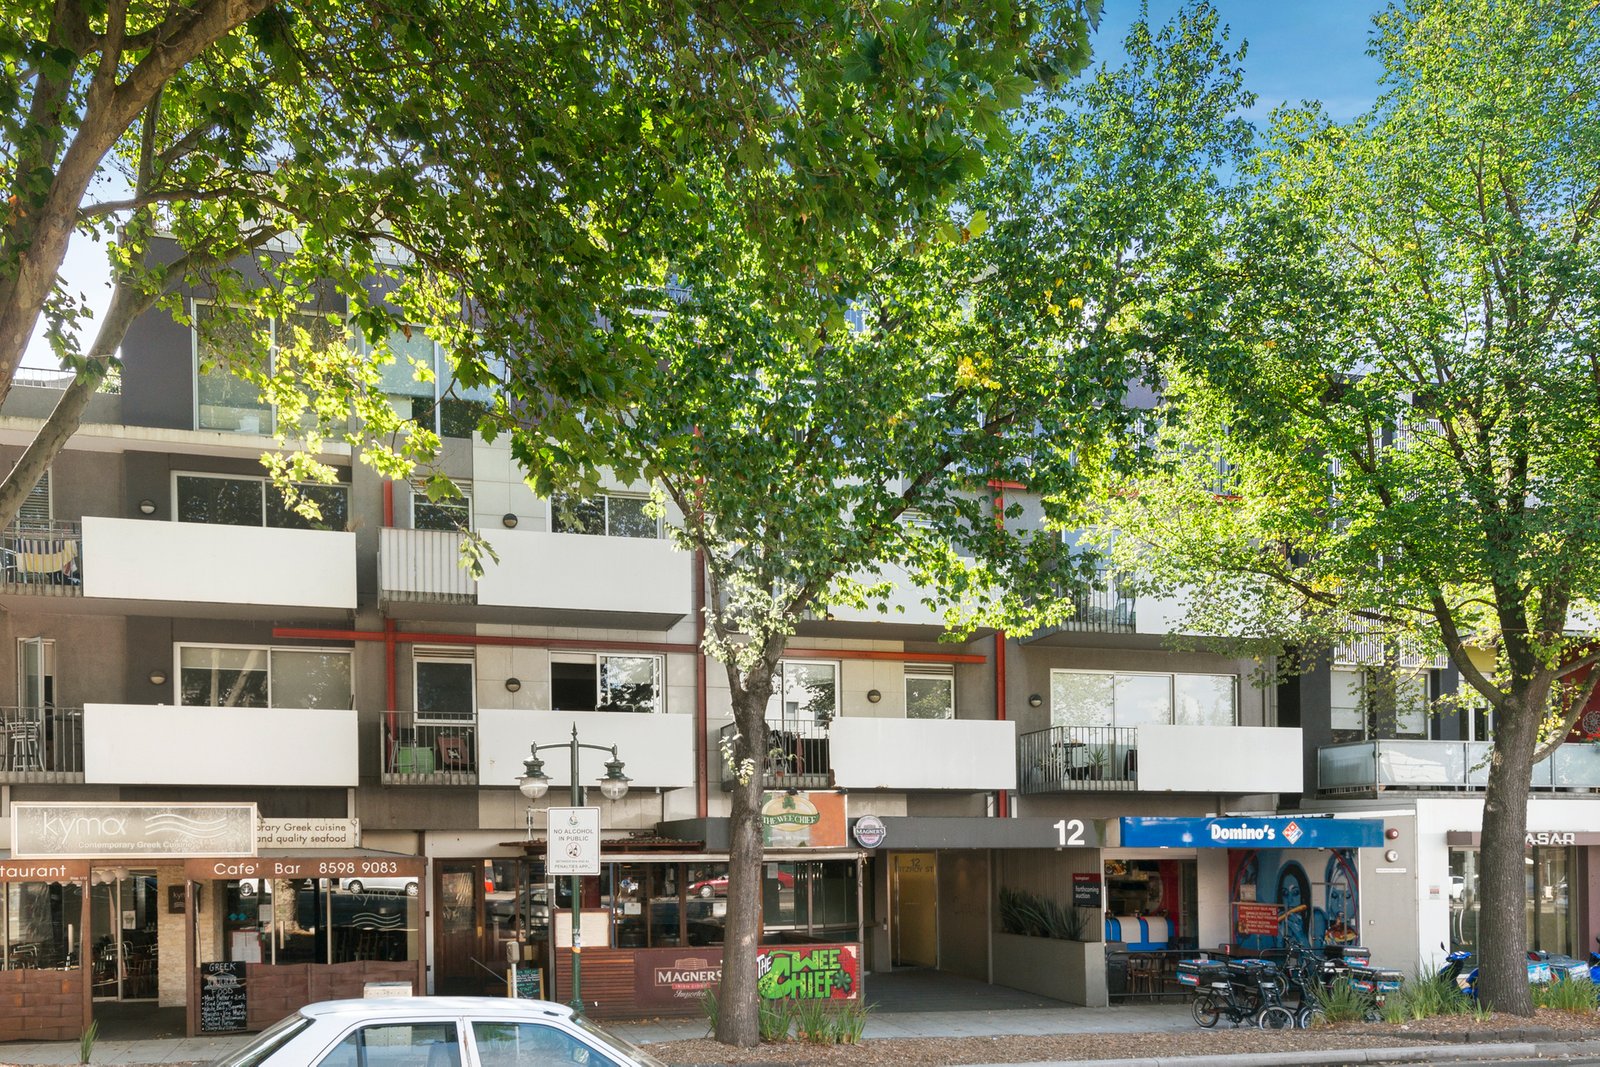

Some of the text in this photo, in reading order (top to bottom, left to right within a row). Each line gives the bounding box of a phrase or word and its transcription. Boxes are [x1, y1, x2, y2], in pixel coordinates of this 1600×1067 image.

[777, 815, 795, 823] WEE
[794, 815, 817, 824] CHIEF
[284, 823, 311, 832] Greek
[315, 824, 346, 832] cuisine
[1053, 819, 1085, 846] 12
[1211, 823, 1276, 840] Domino's
[276, 833, 307, 845] quality
[311, 833, 347, 843] seafood
[78, 841, 135, 850] Contemporary
[136, 841, 161, 849] Greek
[0, 865, 67, 878] taurant
[274, 863, 301, 874] Bar
[319, 862, 355, 874] 8598
[361, 862, 398, 873] 9083
[780, 949, 841, 971] WEE
[209, 962, 236, 971] GREEK
[757, 955, 772, 979] THE
[758, 956, 839, 1000] CHIEF
